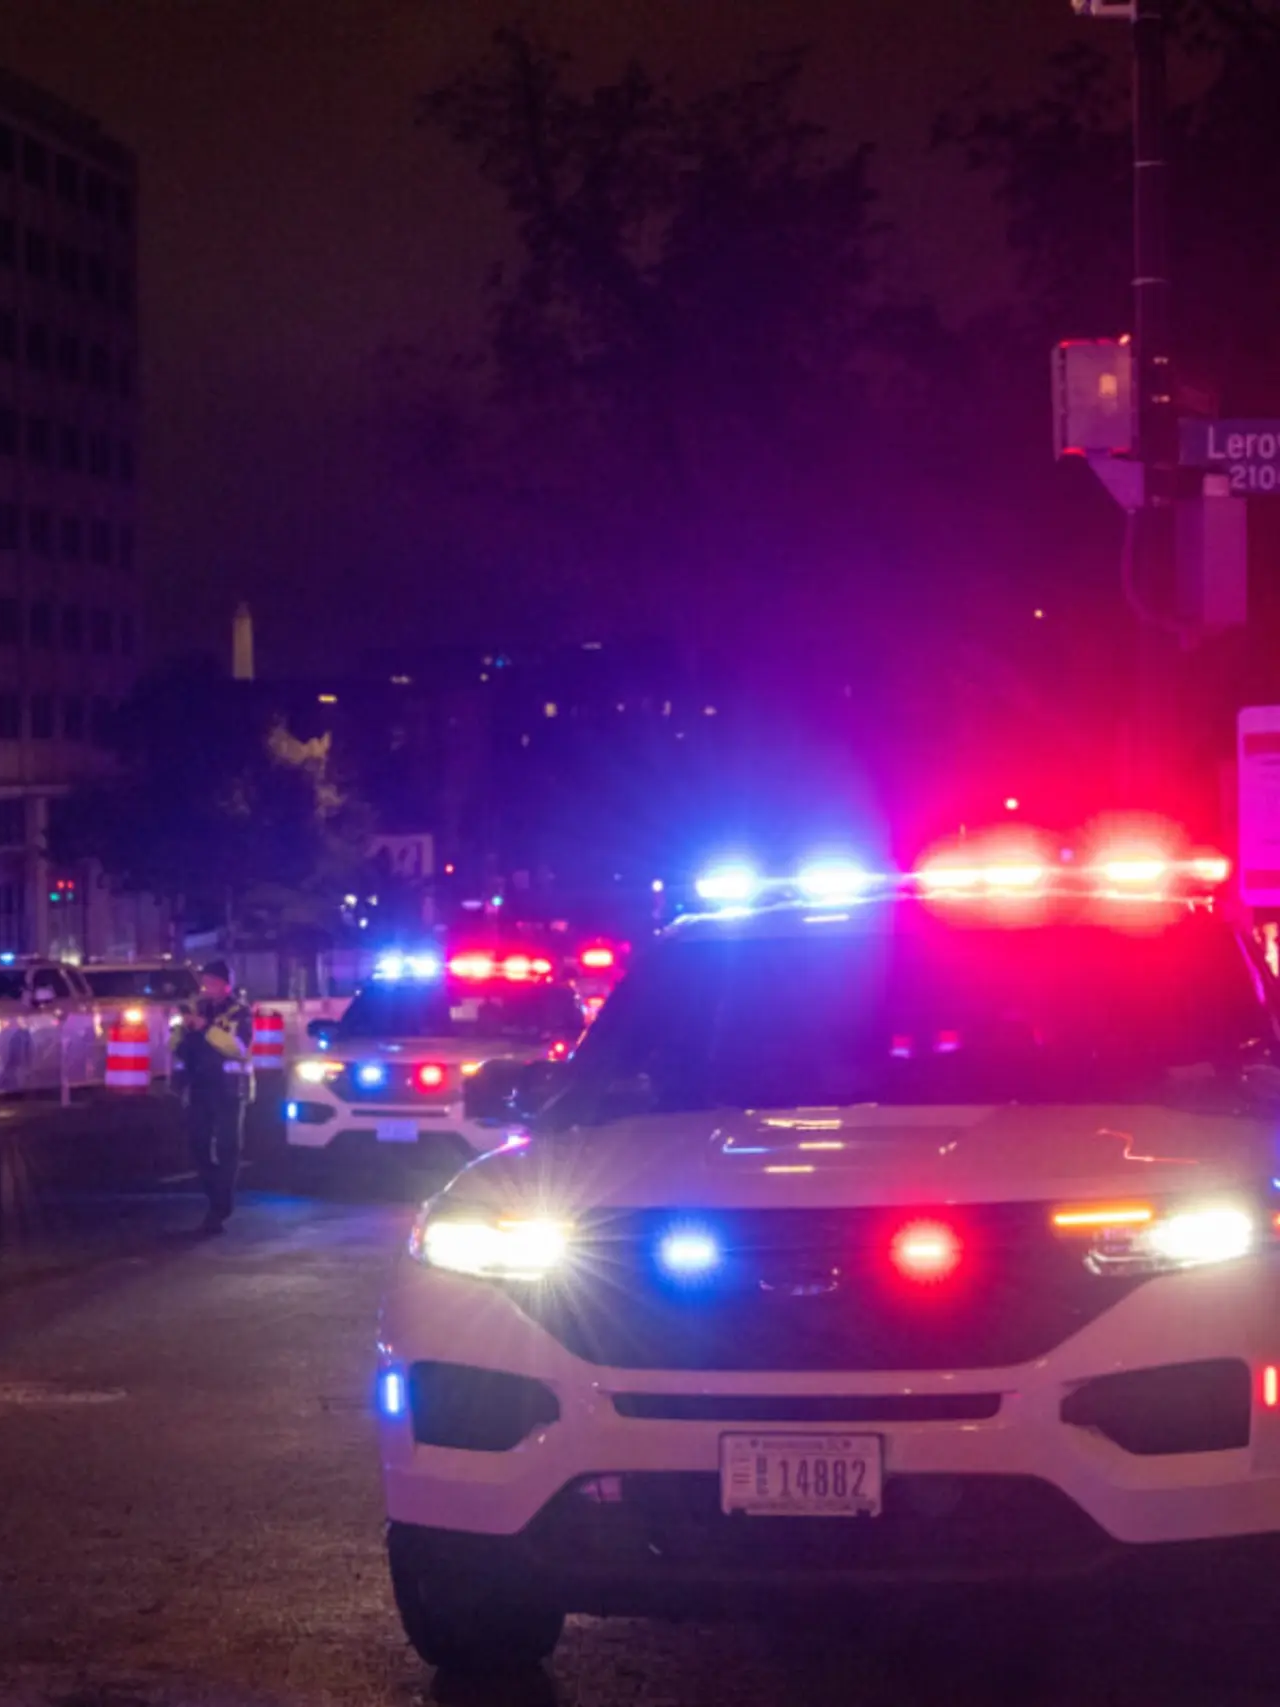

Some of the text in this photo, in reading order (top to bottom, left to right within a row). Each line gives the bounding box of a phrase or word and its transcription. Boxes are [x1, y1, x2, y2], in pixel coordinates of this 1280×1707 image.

[1207, 424, 1280, 459] Lero
[1229, 464, 1280, 490] 210
[778, 1459, 867, 1498] 14882
